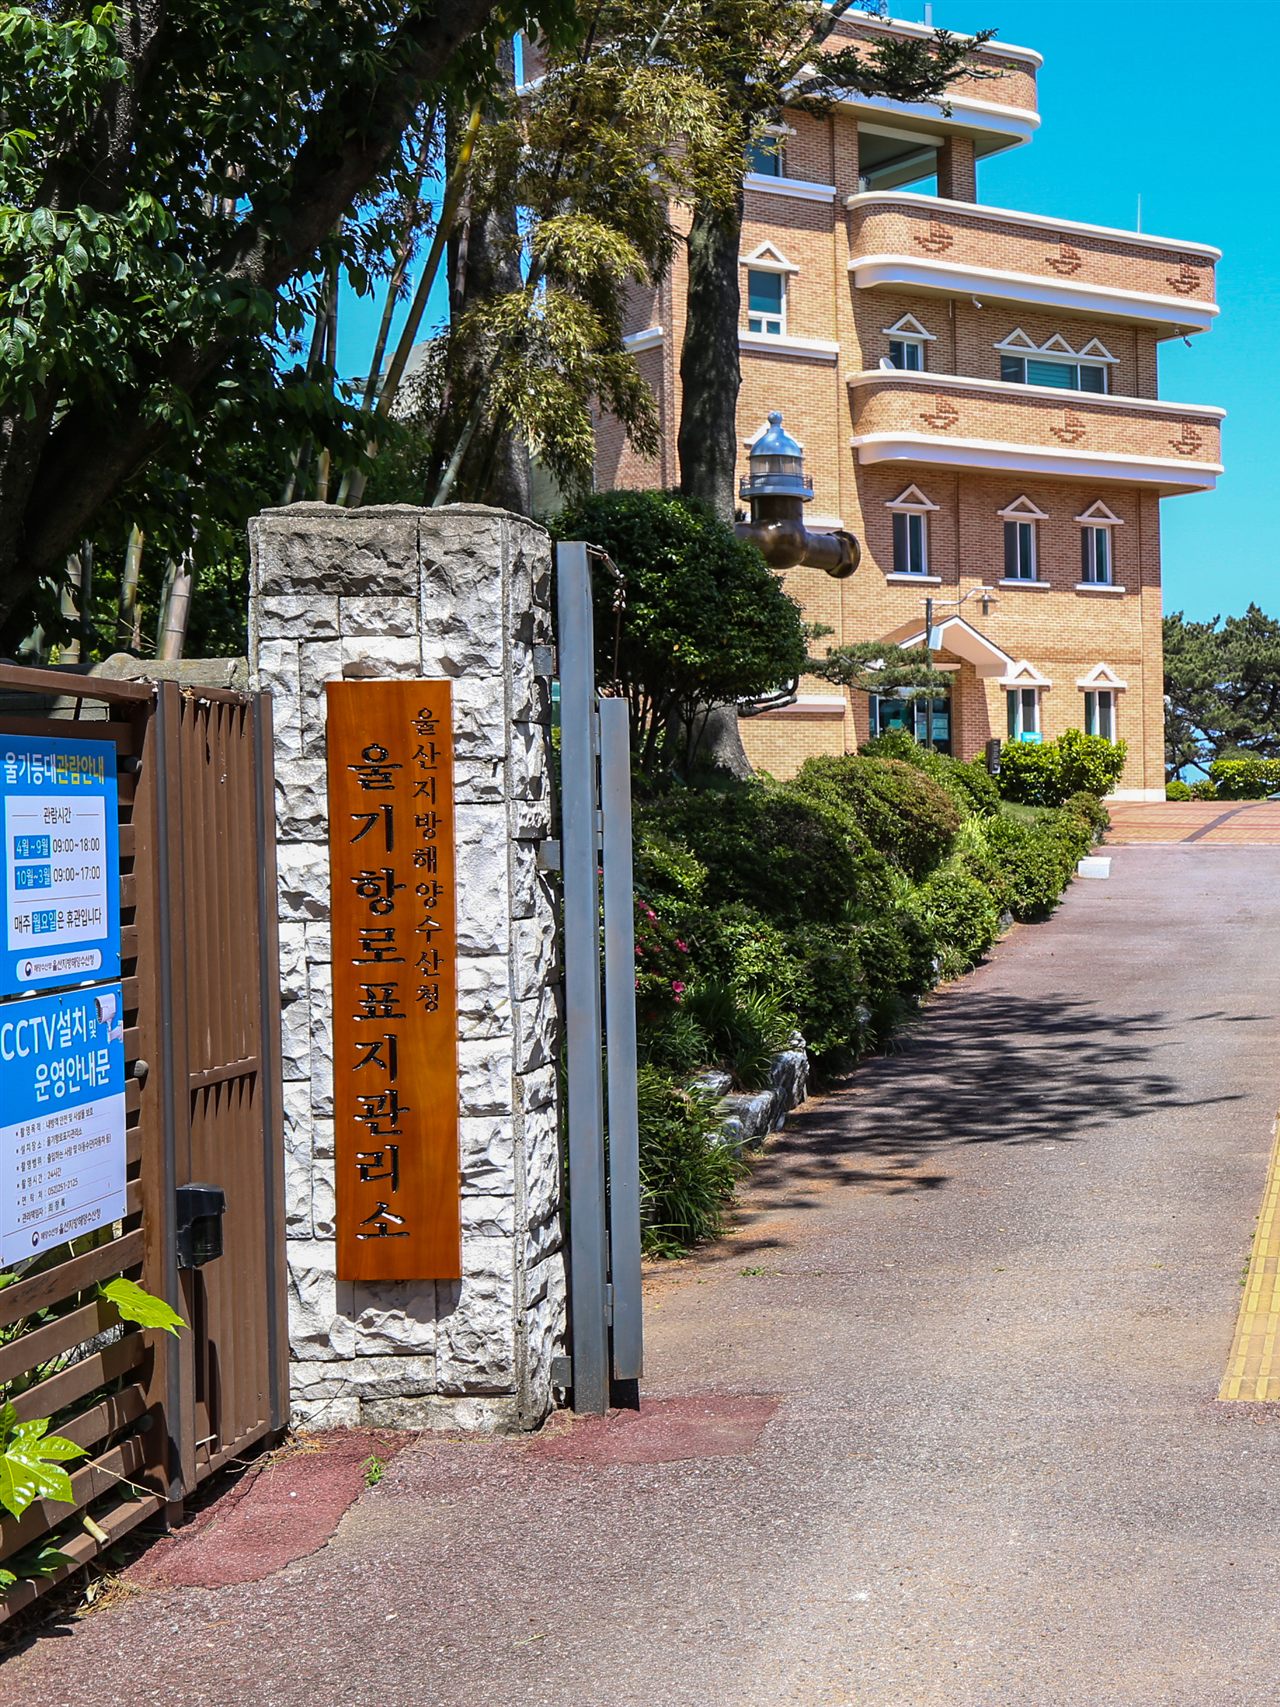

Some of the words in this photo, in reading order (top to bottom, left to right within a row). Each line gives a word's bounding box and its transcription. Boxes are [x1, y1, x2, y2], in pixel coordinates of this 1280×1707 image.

[43, 807, 71, 824] 관람시간
[52, 838, 100, 853] 09:00~18:00
[410, 706, 446, 1014] 울산지방해양수산청
[53, 866, 100, 882] 09:00~17:00
[14, 914, 31, 934] 매주
[66, 907, 102, 928] 휴관입니다
[347, 742, 409, 1241] 울기항로표지관리소
[88, 1018, 97, 1039] 및
[34, 1049, 110, 1103] 운영안내문
